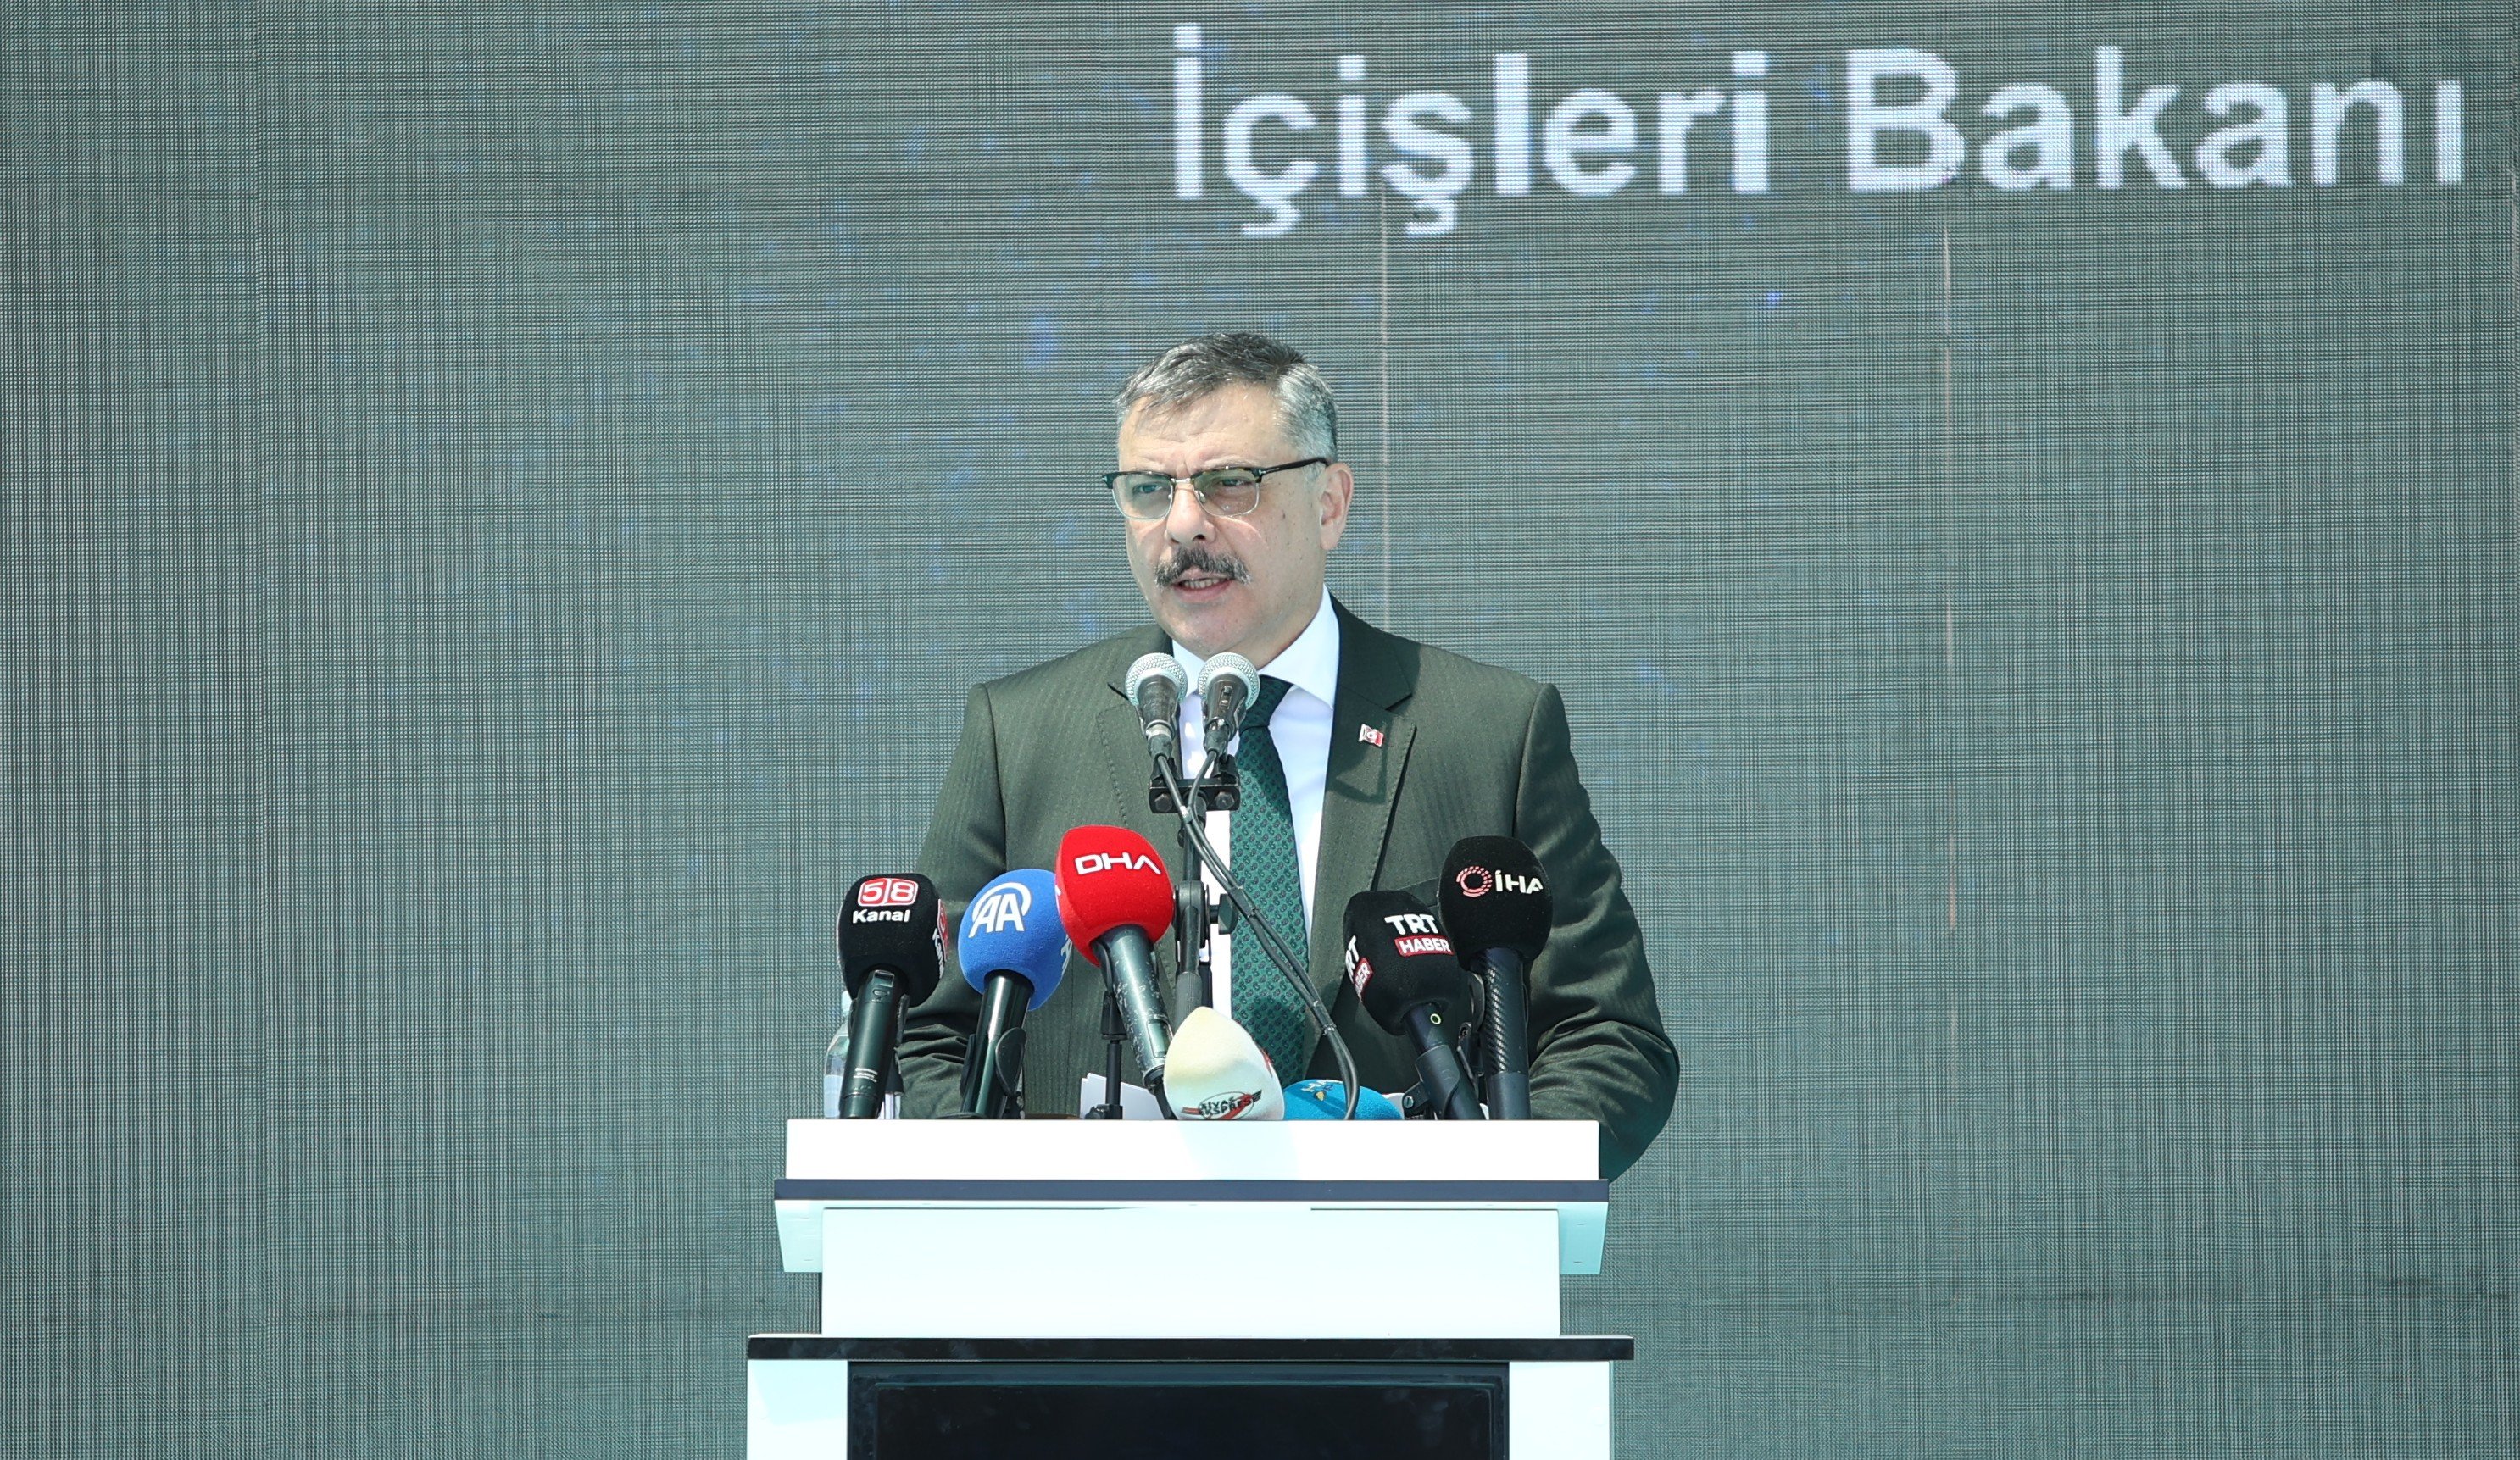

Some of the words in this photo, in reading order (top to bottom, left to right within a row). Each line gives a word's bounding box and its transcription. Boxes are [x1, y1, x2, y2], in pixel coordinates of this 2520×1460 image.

[1171, 21, 1772, 240] İçişleri
[1843, 45, 2464, 194] Bakanı
[1075, 852, 1161, 875] DHA
[853, 908, 910, 924] Kanal
[969, 893, 1025, 938] AA
[1384, 913, 1438, 935] TRT
[1399, 938, 1451, 954] HABER
